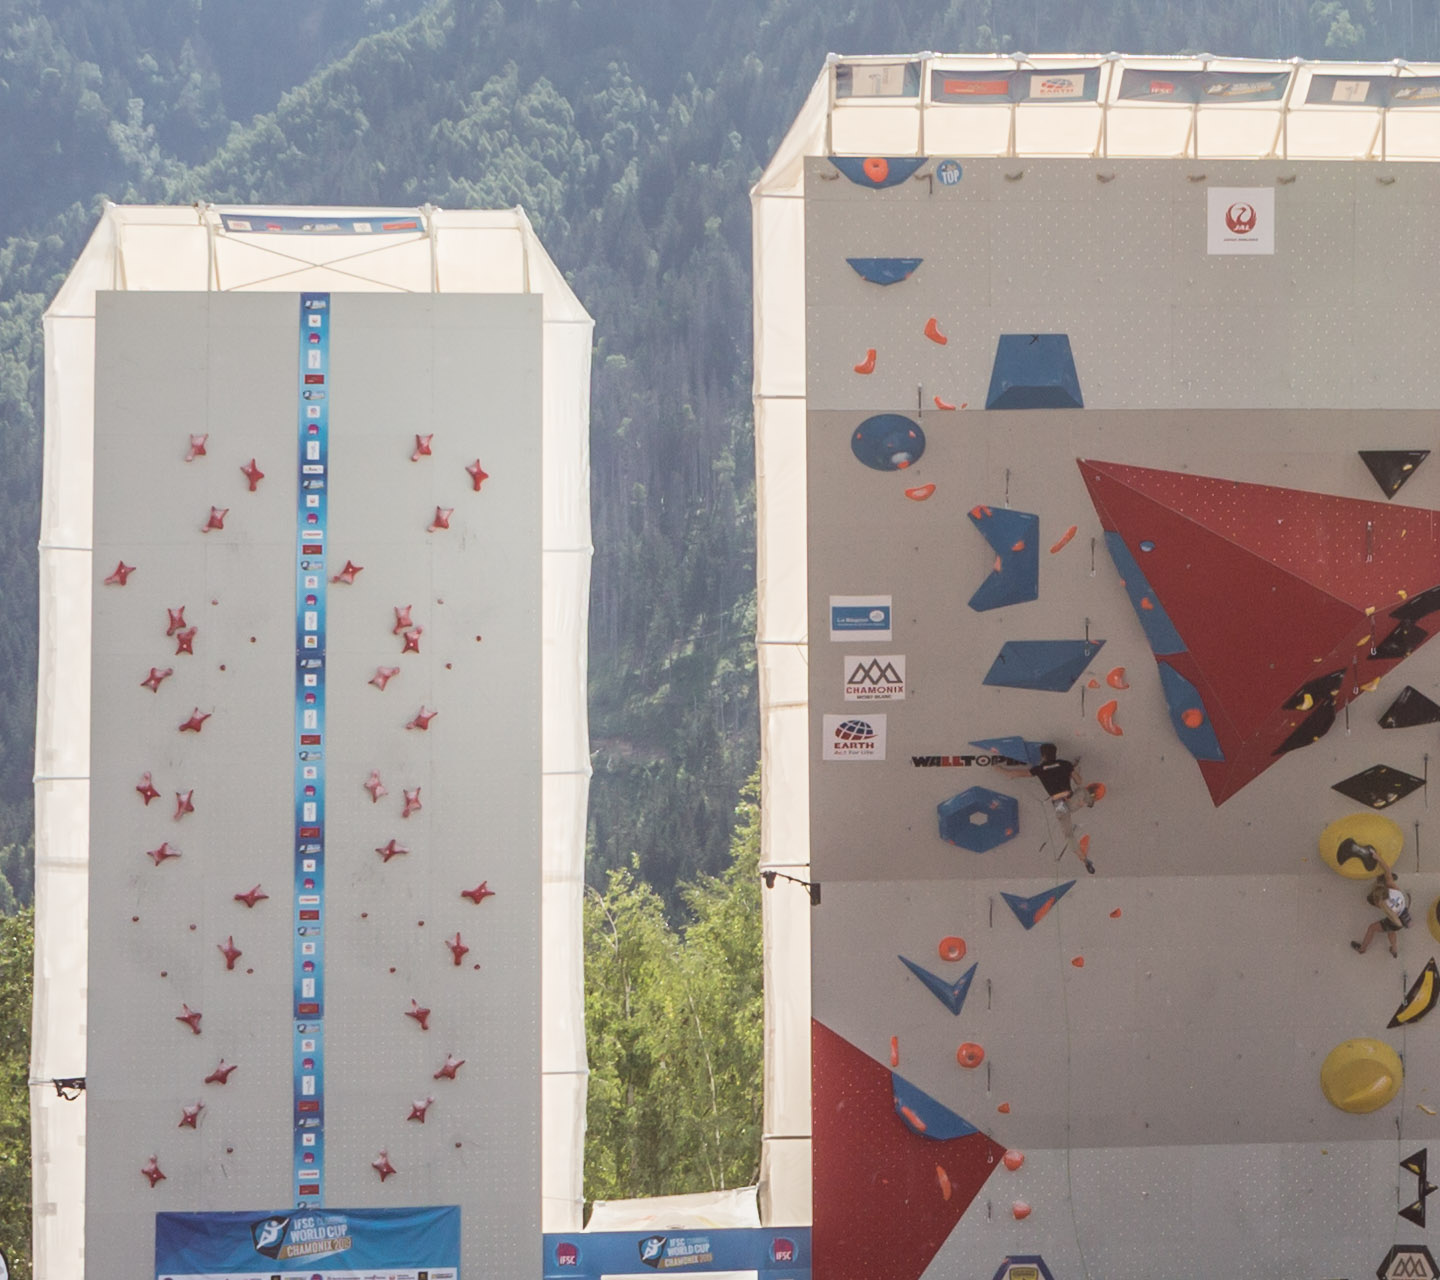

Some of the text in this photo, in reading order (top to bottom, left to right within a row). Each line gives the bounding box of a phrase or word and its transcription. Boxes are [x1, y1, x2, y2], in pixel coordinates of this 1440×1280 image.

[941, 170, 960, 185] TOP
[846, 685, 905, 695] CHAMONIX
[833, 742, 875, 750] EARTH
[293, 1218, 315, 1230] IFSC
[290, 1224, 349, 1243] WORLD CUP
[286, 1239, 333, 1257] CHAMONIX
[669, 1238, 686, 1247] IFSC
[667, 1243, 710, 1257] WORLD CUP
[775, 1251, 792, 1261] IFSC
[559, 1255, 576, 1265] IFSC
[664, 1255, 699, 1268] CHAMONIX
